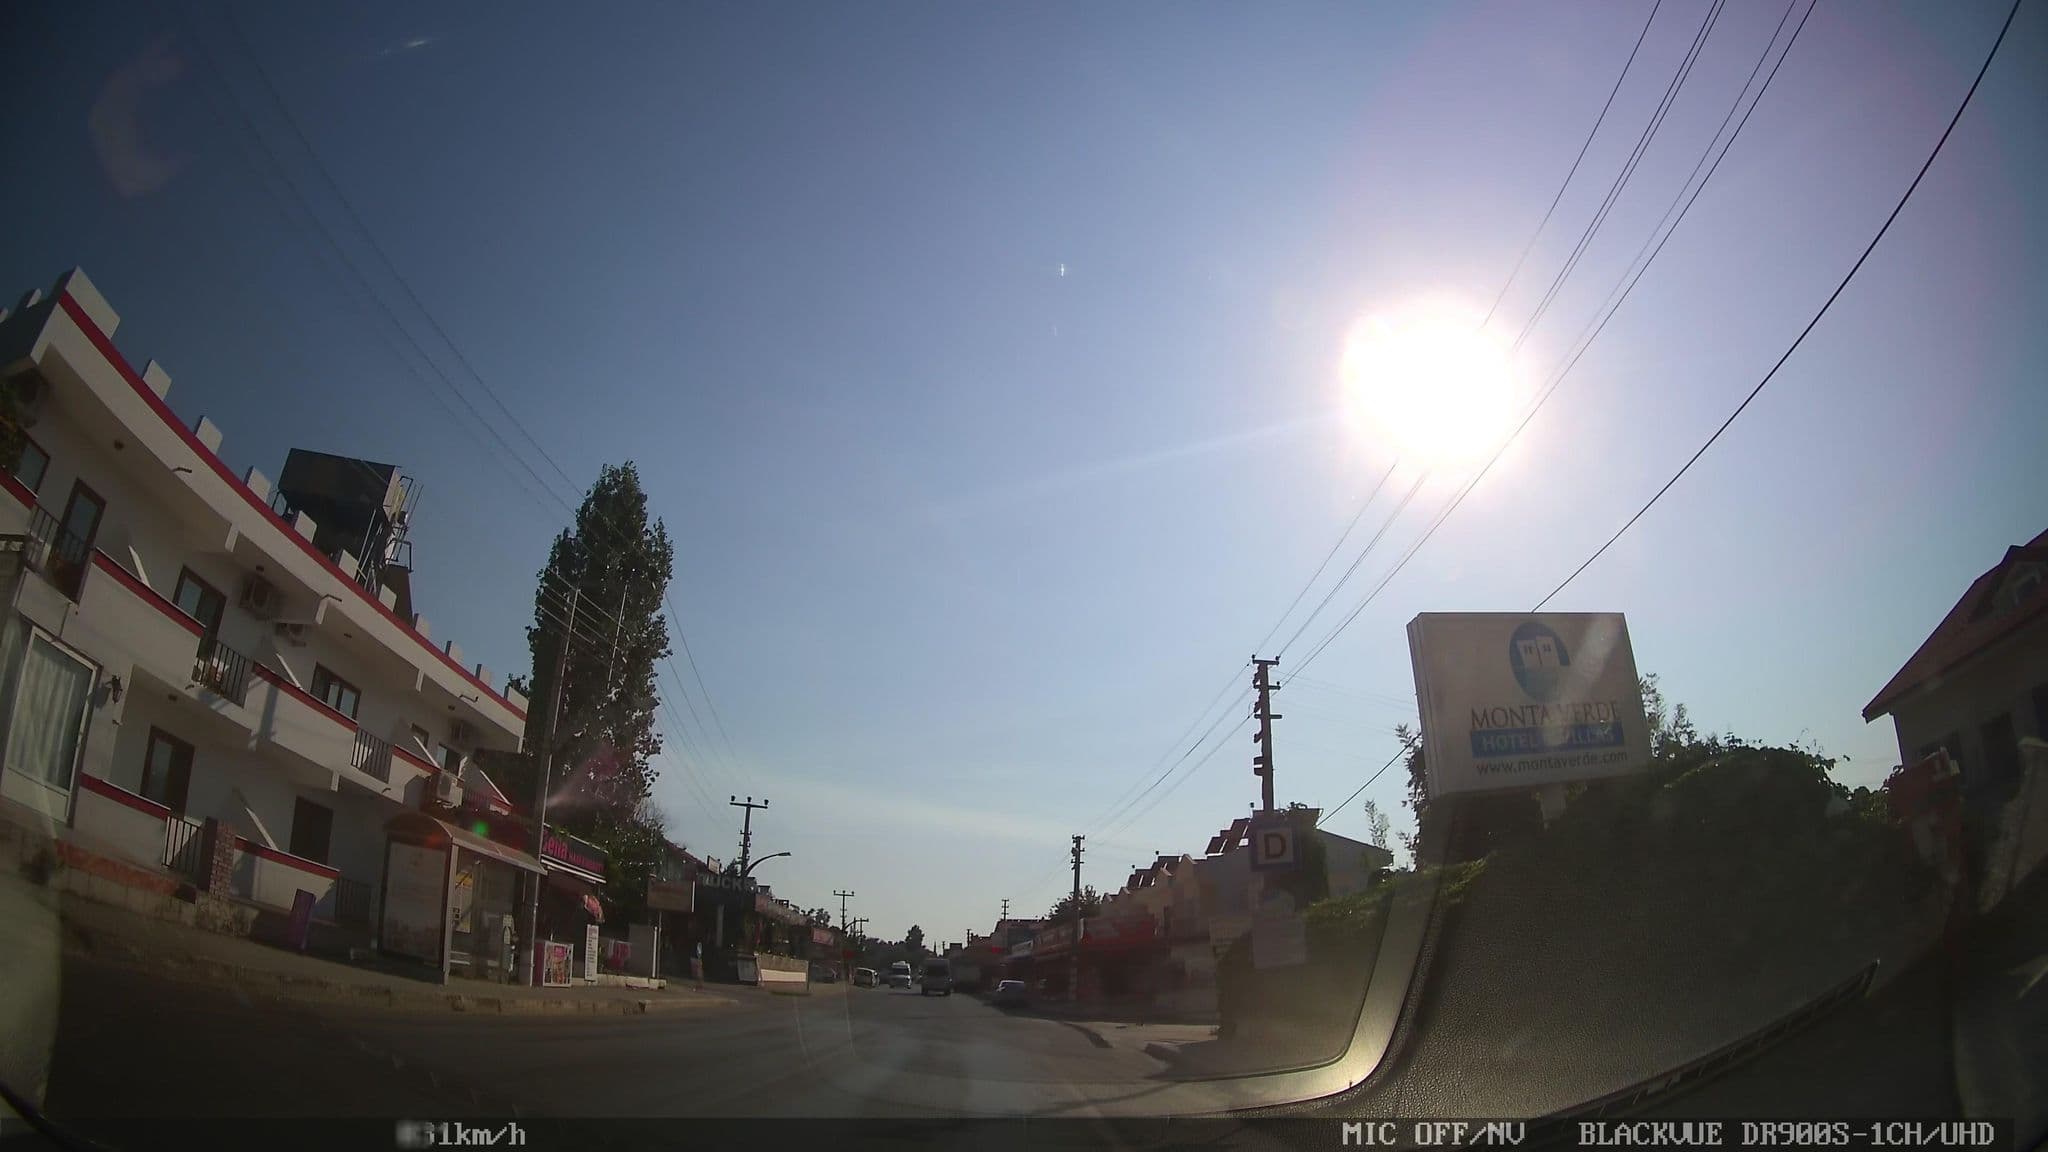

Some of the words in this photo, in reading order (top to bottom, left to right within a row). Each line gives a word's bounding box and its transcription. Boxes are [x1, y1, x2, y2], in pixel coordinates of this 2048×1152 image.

[1481, 734, 1541, 752] HOTEL
[1476, 751, 1628, 776] www.montaverde.com
[1264, 832, 1287, 859] D
